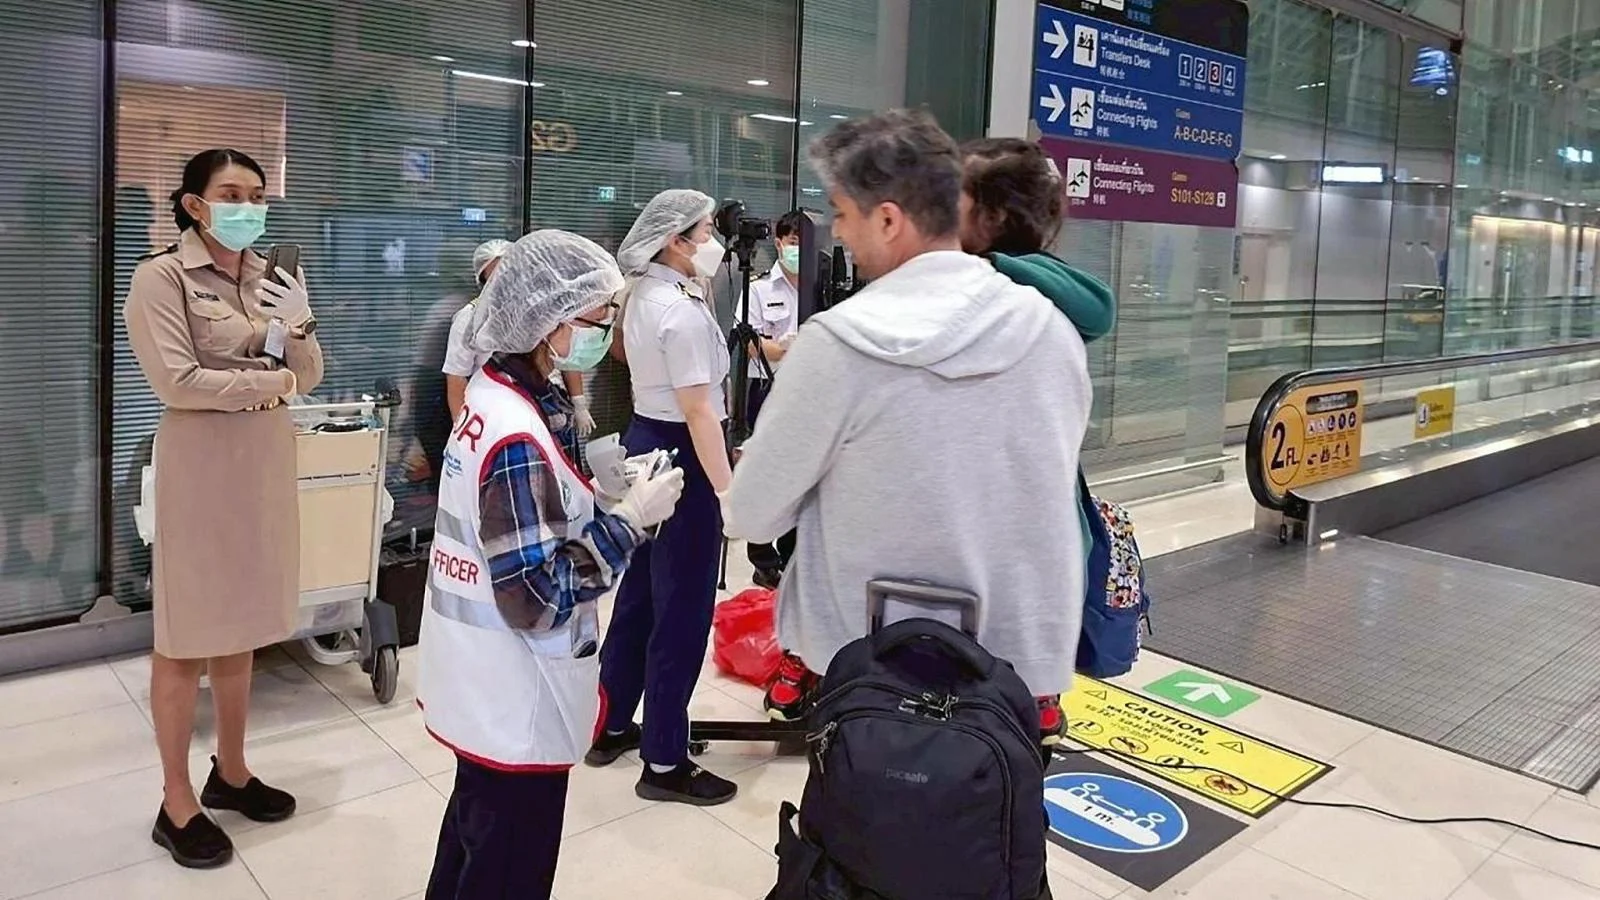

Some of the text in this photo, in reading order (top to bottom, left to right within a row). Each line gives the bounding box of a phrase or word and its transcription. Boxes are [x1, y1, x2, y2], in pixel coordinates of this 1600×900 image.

[1101, 46, 1151, 69] Transfers Desk
[1183, 60, 1233, 86] 1 2 3 4
[1096, 108, 1158, 131] Connecting Flights
[1174, 124, 1233, 148] A-B-C-D-E-F-G
[1093, 176, 1155, 195] Connecting Flights
[1271, 421, 1286, 470] 2
[1106, 704, 1143, 721] WATCH
[1145, 719, 1175, 735] YOUR
[1177, 731, 1205, 745] STEP
[1124, 701, 1210, 737] CAUTION
[885, 767, 929, 784] pacsafe
